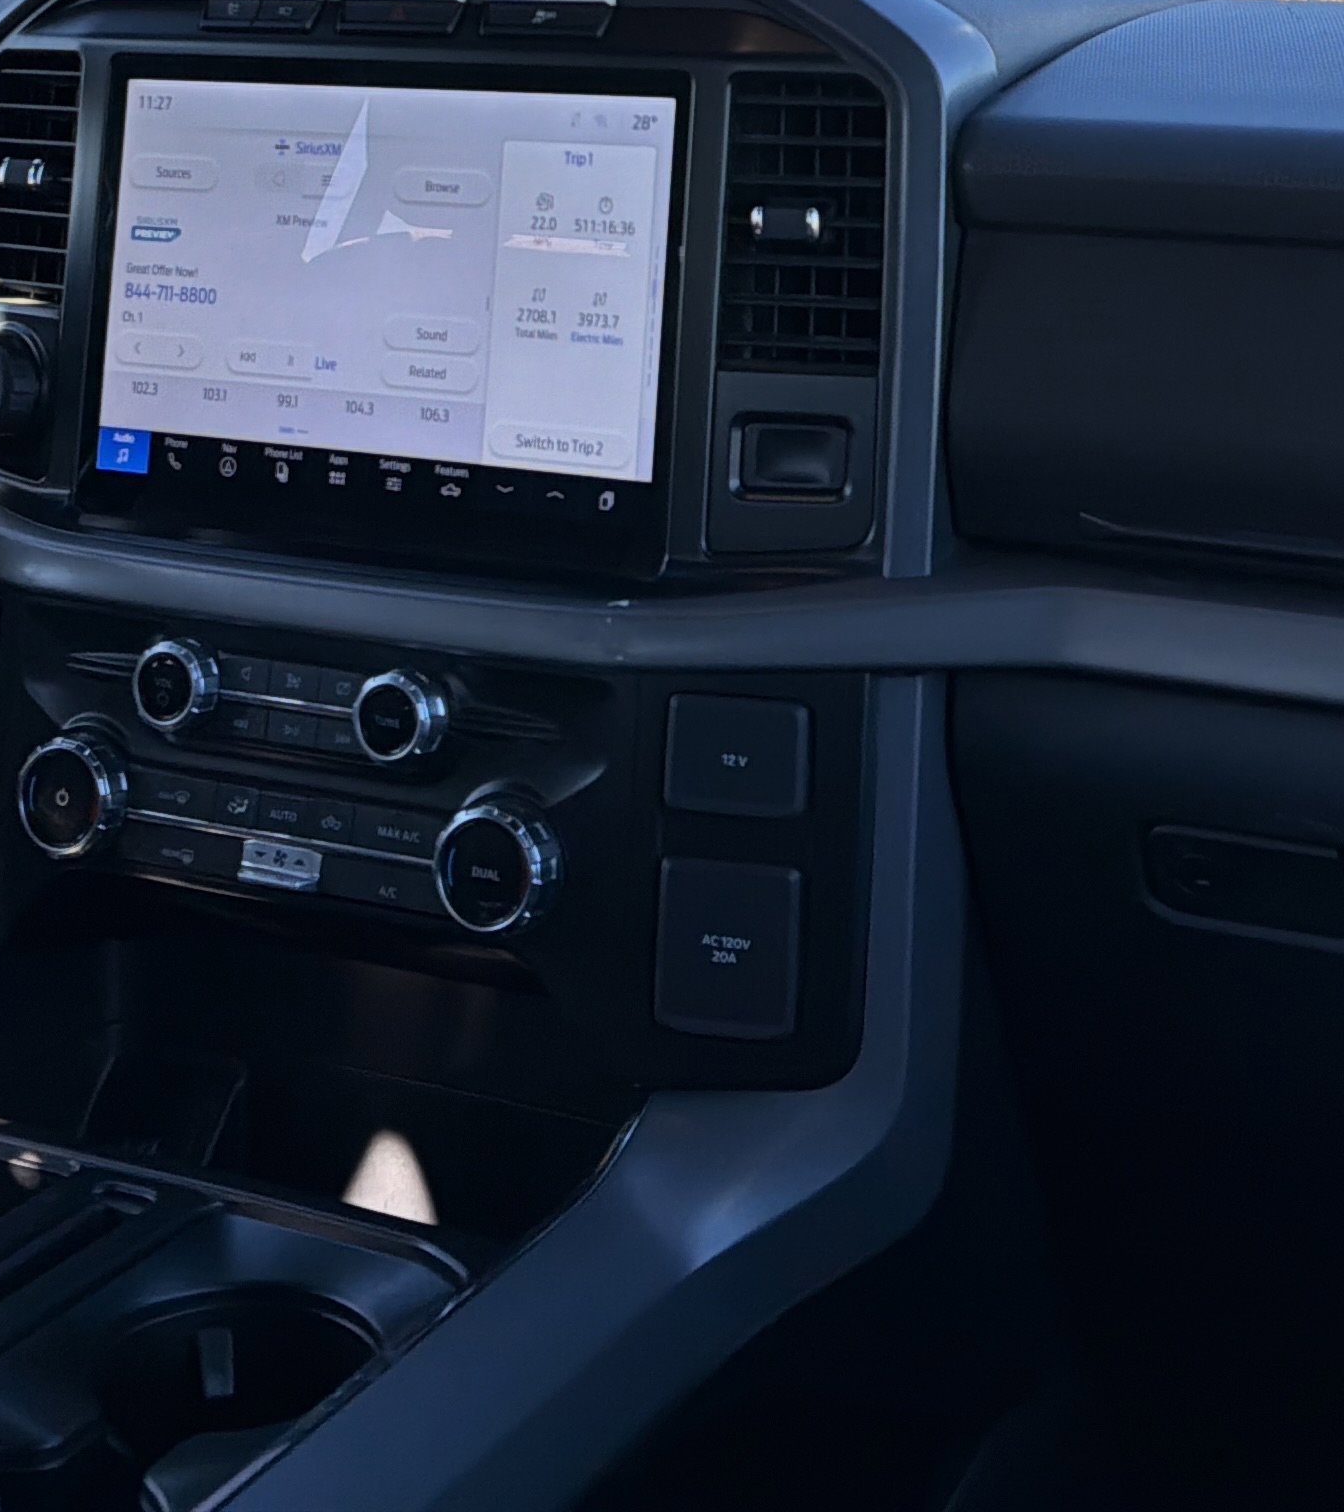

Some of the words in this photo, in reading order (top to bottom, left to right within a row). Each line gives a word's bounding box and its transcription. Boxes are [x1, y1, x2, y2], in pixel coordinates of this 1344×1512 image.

[138, 96, 173, 110] 11:27
[295, 141, 342, 157] SiriusXM
[564, 151, 586, 167] Trip
[156, 166, 192, 180] Sources
[425, 180, 460, 194] Browse
[276, 215, 291, 227] XM
[292, 215, 328, 229] Preview
[530, 216, 558, 230] 22.0
[126, 262, 150, 275] Great
[151, 264, 174, 277] Offer
[175, 266, 199, 278] Now!
[124, 281, 217, 305] 844-711-8800
[122, 310, 137, 323] Ch.
[517, 308, 557, 324] 2708.1
[577, 312, 619, 329] 3973.7
[416, 327, 448, 342] Sound
[515, 326, 536, 339] Total
[570, 331, 600, 344] Electric
[314, 357, 337, 371] Live
[409, 365, 447, 380] Related
[131, 381, 158, 396] 102.3
[202, 387, 227, 402] 103.1
[277, 393, 299, 409] 99.1
[345, 399, 374, 416] 104.3
[420, 407, 450, 423] 106.3
[112, 432, 136, 444] Audio
[164, 437, 189, 449] Phone
[515, 434, 554, 451] Switch
[556, 438, 570, 453] to
[572, 439, 595, 456] Trip
[221, 442, 238, 455] Nav
[264, 446, 289, 459] Phone
[329, 453, 349, 466] Apps
[379, 458, 412, 474] Settings
[721, 753, 737, 768] 12
[737, 755, 749, 769] V
[269, 807, 298, 823] AUTO
[377, 825, 400, 842] MAX
[401, 829, 421, 845] A/C
[471, 865, 501, 883] DUAL
[378, 885, 398, 900] A/C
[701, 933, 719, 948] AC
[720, 936, 752, 951] 120V
[711, 950, 738, 964] 20A
